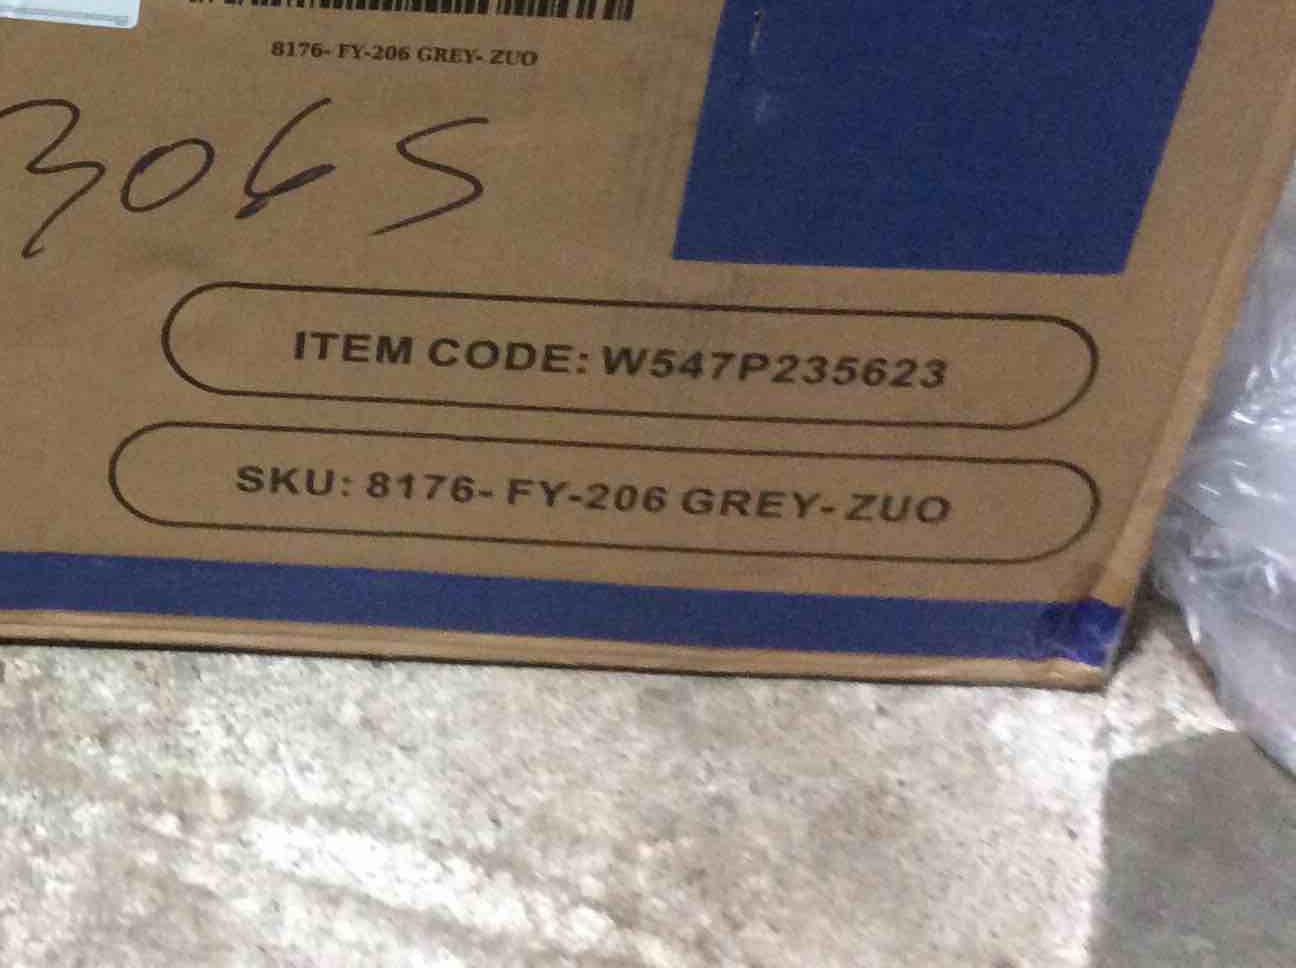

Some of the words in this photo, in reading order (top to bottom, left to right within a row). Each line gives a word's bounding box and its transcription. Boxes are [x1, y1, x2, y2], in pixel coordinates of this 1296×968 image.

[337, 43, 411, 62] FY-206
[489, 49, 539, 68] ZUO
[294, 330, 413, 367] ITEM
[428, 336, 590, 376] CODE:
[602, 343, 949, 390] W547P235623
[235, 465, 353, 499] SKU:
[365, 470, 494, 506] 8176-
[507, 478, 667, 514] FY-206
[680, 486, 839, 523] GREY-
[847, 493, 953, 525] ZUO
